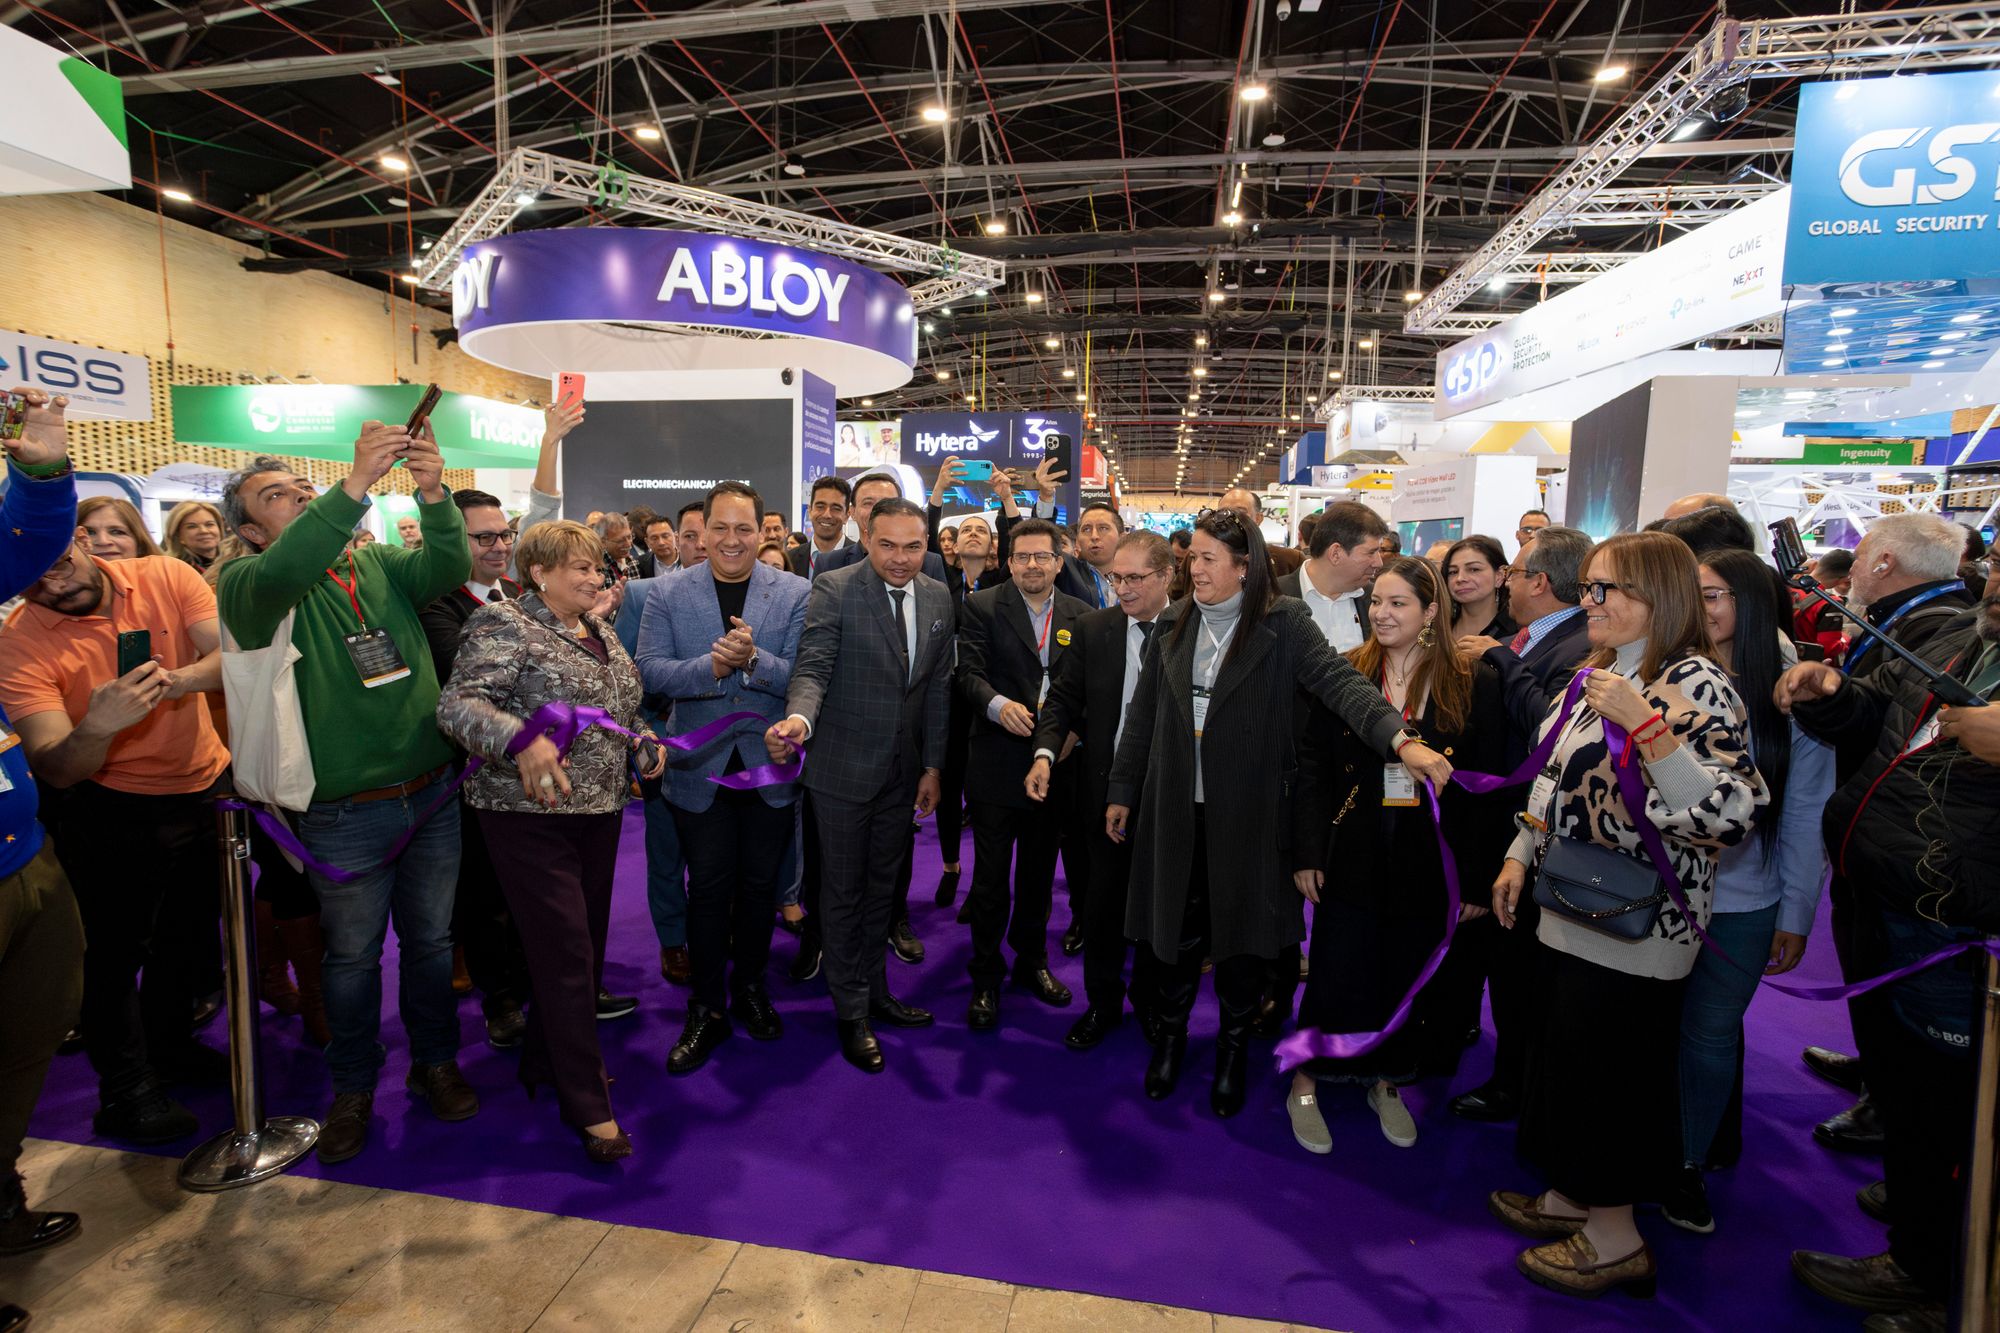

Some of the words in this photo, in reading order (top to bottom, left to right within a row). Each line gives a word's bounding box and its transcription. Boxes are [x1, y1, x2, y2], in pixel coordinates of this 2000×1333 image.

[1838, 122, 2000, 207] GS
[1808, 218, 1882, 236] GLOBAL
[1895, 214, 1988, 233] SECURITY
[1728, 233, 1763, 261] CAME
[452, 252, 494, 322] OY
[656, 247, 850, 322] ABLOY
[1732, 265, 1765, 288] NEXXT
[1512, 342, 1543, 361] SECURITY
[1513, 333, 1539, 349] GLOBAL
[18, 345, 126, 396] ISS
[1511, 350, 1552, 372] PROTECTION
[915, 432, 979, 457] Hytera
[1839, 448, 1892, 459] Ingenuity
[1320, 471, 1349, 482] Hytera
